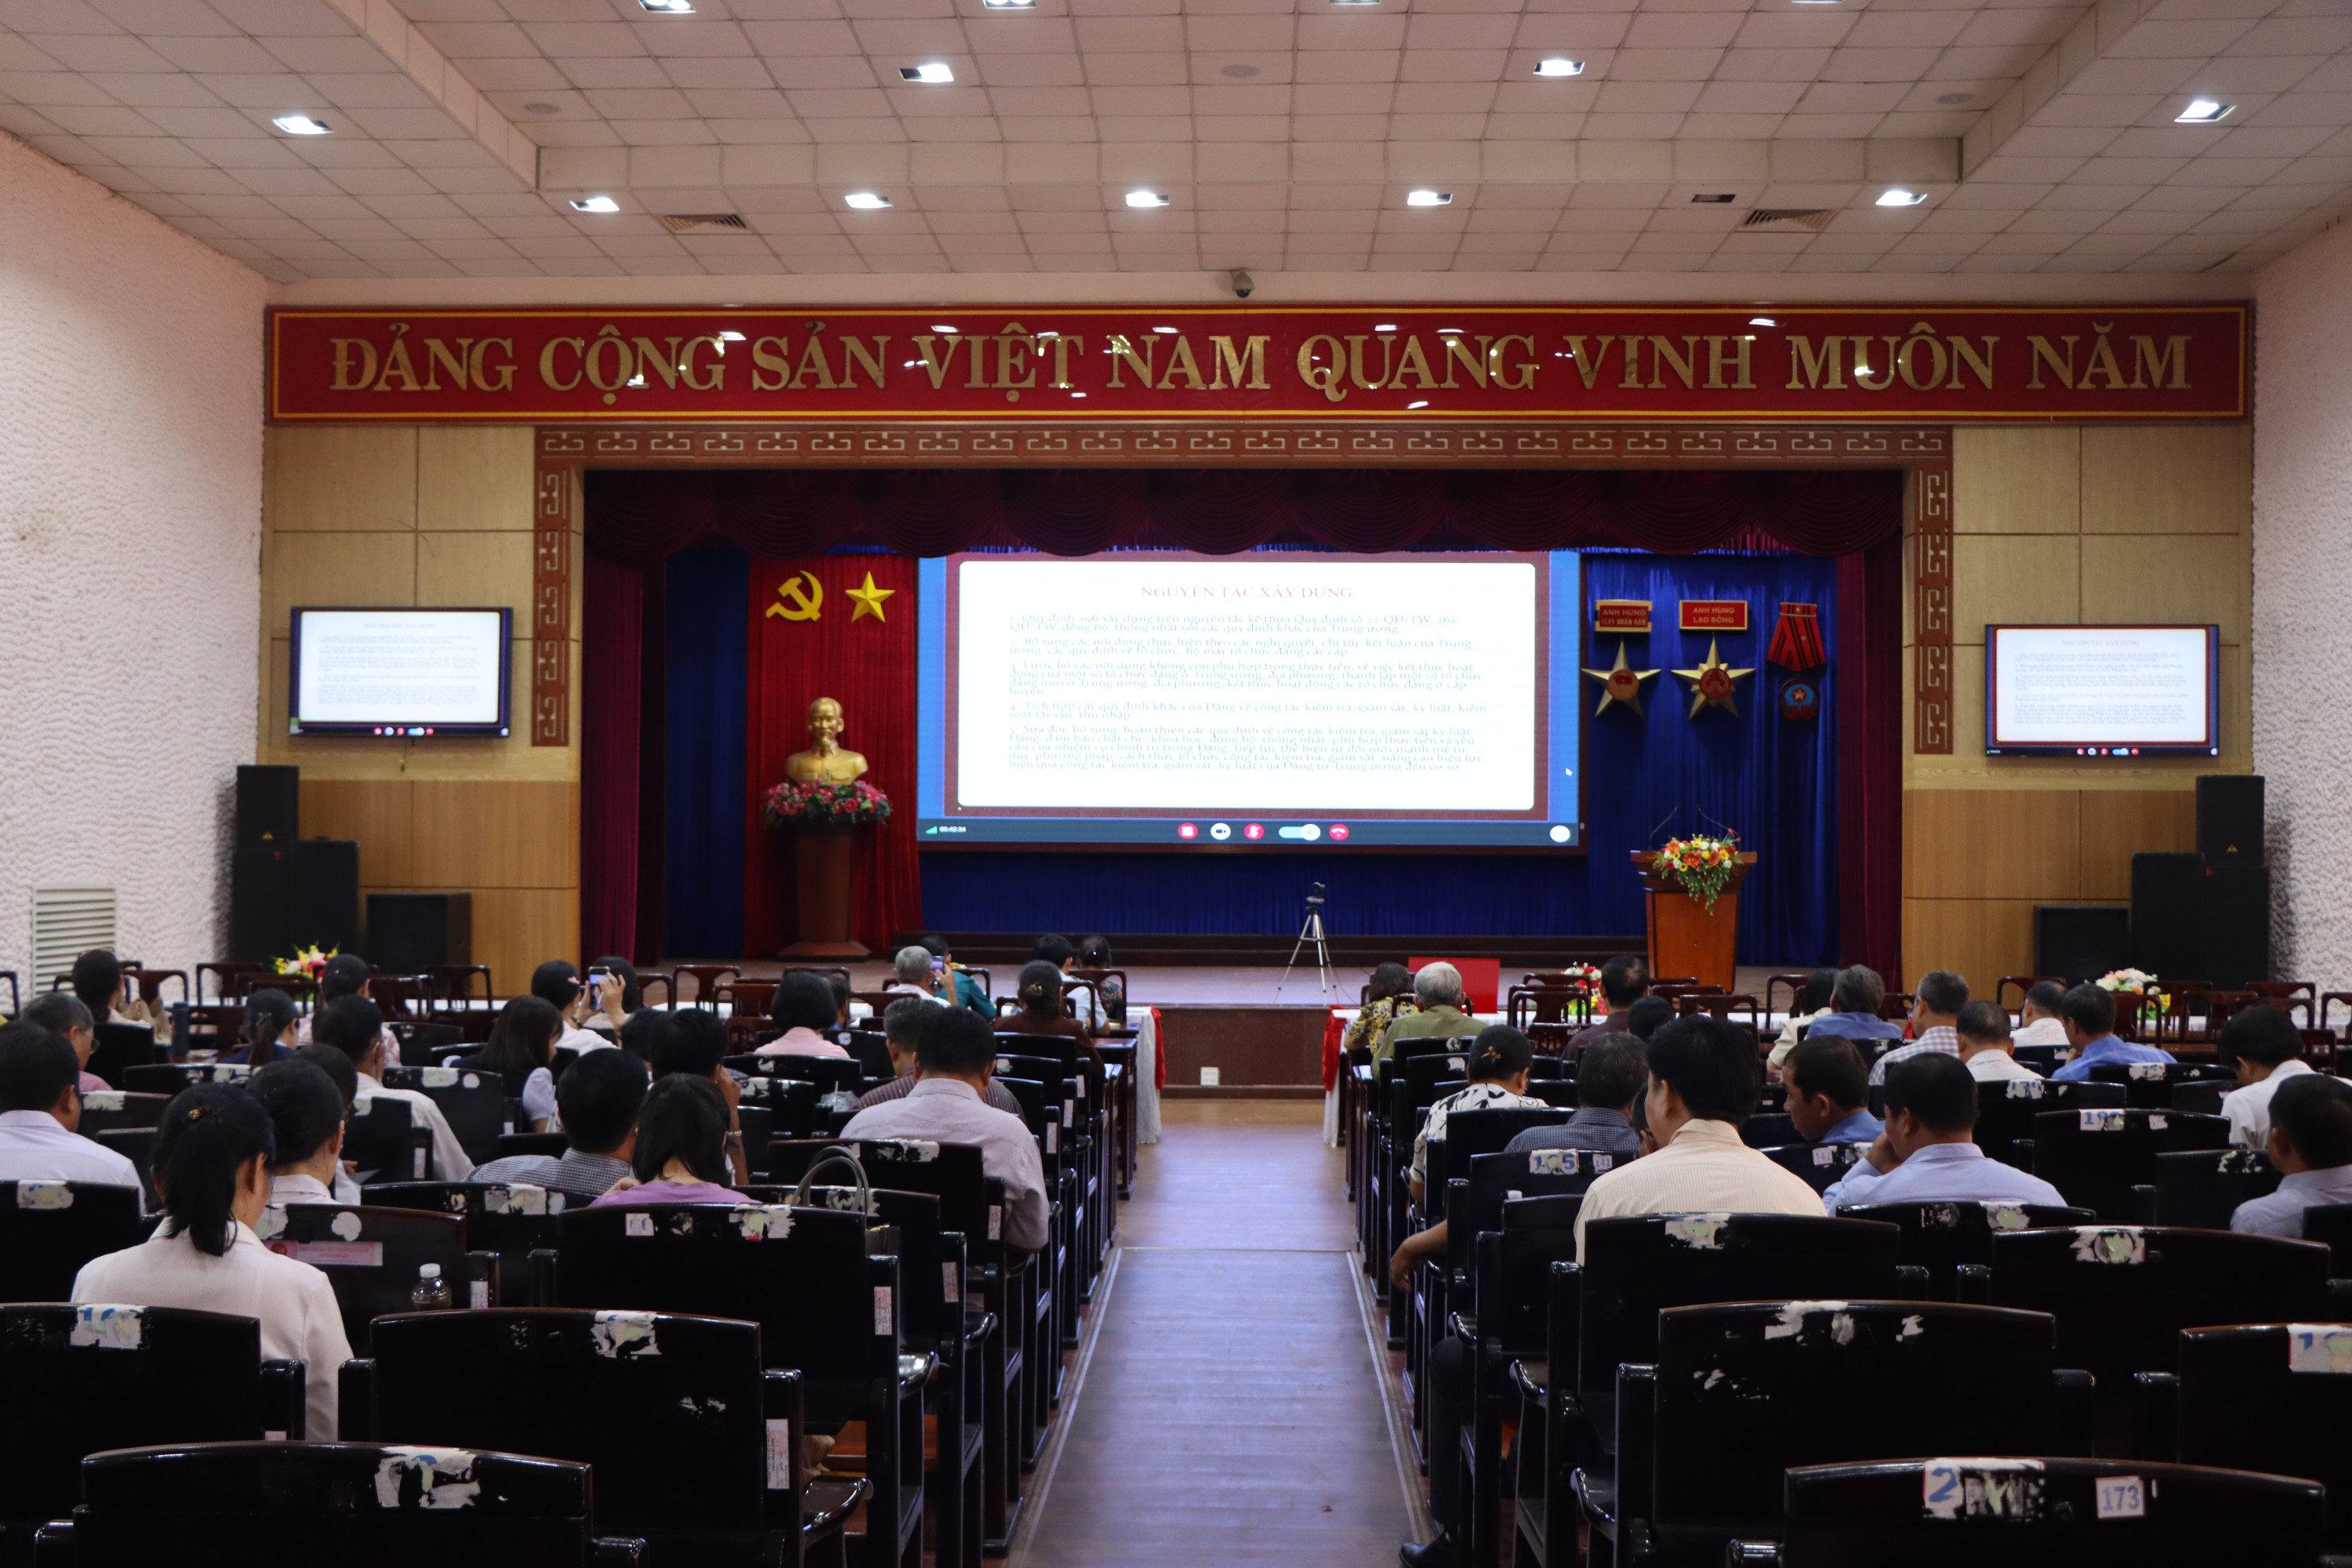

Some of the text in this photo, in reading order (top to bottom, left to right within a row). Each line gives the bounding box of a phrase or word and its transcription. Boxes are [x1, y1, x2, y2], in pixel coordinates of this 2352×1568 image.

[330, 321, 2192, 405] ĐẢNG CỘNG SẢN VIỆT NAM QUANG VINH MUÔN NĂM
[1141, 584, 1214, 597] NGUYÊN
[1259, 585, 1296, 597] XÂY
[1301, 586, 1352, 599] DỰNG
[1022, 612, 1045, 623] Quy
[1049, 613, 1074, 623] định
[1102, 613, 1118, 624] xây
[1123, 613, 1153, 624] dựng
[1156, 613, 1179, 622] trên
[1183, 613, 1224, 624] nguyên
[1228, 613, 1243, 622] tắc
[1248, 613, 1260, 622] kế
[1264, 614, 1290, 622] thừa
[1294, 614, 1317, 625] Quy
[1321, 614, 1347, 624] định
[1350, 614, 1362, 623] số
[1622, 608, 1646, 616] HÙNG
[1711, 615, 1734, 624] ĐỘNG
[1062, 621, 1090, 633] đồng
[1115, 622, 1148, 633] thống
[1152, 622, 1177, 631] nhất
[1181, 622, 1198, 631] với
[1202, 623, 1218, 631] các
[1247, 623, 1273, 633] định
[1277, 623, 1302, 631] khác
[1306, 623, 1326, 632] của
[1330, 623, 1363, 634] Trung
[1024, 635, 1038, 644] Bổ
[1042, 639, 1068, 647] sung
[1071, 636, 1088, 645] các
[1093, 637, 1111, 647] nội
[1114, 637, 1143, 648] dung
[1147, 637, 1172, 647] thực
[1177, 637, 1201, 647] hiện
[1205, 637, 1230, 646] theo
[1233, 637, 1250, 646] các
[1255, 637, 1280, 648] nghị
[1366, 637, 1382, 647] kết
[1386, 638, 1411, 648] luận
[1414, 638, 1434, 647] của
[1438, 638, 1471, 649] Trung
[1047, 645, 1063, 654] các
[1068, 648, 1087, 656] quy
[1091, 645, 1117, 656] định
[1121, 645, 1133, 654] về
[1136, 645, 1147, 654] tổ
[1186, 646, 1200, 656] bộ
[1203, 646, 1225, 657] máy
[1230, 645, 1241, 654] tổ
[1244, 646, 1271, 655] chức
[1275, 646, 1303, 657] đảng
[1306, 646, 1323, 655] các
[1024, 660, 1053, 671] Lược
[1057, 660, 1071, 669] bỏ
[1074, 660, 1091, 669] các
[1095, 660, 1113, 671] nội
[1117, 660, 1145, 671] dung
[1149, 660, 1185, 672] không
[1188, 661, 1208, 669] còn
[1212, 661, 1234, 672] phù
[1238, 661, 1261, 672] hợp
[1264, 661, 1295, 672] trong
[1298, 661, 1324, 672] thực
[1357, 661, 1369, 670] về
[1373, 661, 1393, 672] việc
[1398, 661, 1414, 670] kết
[1418, 662, 1443, 671] thúc
[1448, 662, 1472, 672] hoạt
[1024, 700, 1048, 709] Tích
[1053, 701, 1075, 712] hợp
[1078, 701, 1094, 710] các
[1099, 704, 1118, 712] quy
[1123, 701, 1149, 712] định
[1153, 701, 1178, 710] khác
[1182, 701, 1201, 710] của
[1206, 701, 1235, 713] Đảng
[1239, 701, 1250, 711] về
[1254, 702, 1281, 713] công
[1285, 702, 1300, 711] tác
[1305, 701, 1333, 711] kiểm
[1359, 702, 1386, 714] giám
[1458, 702, 1486, 712] kiểm
[1009, 759, 1033, 770] hiệu
[1036, 759, 1057, 770] quả
[1060, 759, 1087, 771] công
[1091, 759, 1106, 768] tác
[1111, 759, 1139, 768] kiểm
[1164, 760, 1192, 771] giám
[1235, 760, 1256, 771] luật
[1260, 760, 1279, 769] của
[1283, 760, 1313, 772] Đảng
[1316, 760, 1329, 769] từ
[1334, 761, 1367, 772] Trung
[1370, 764, 1401, 772] ương
[1405, 760, 1426, 770] đến
[1534, 1154, 1575, 1171] 15
[1596, 1158, 1610, 1167] 141
[2102, 1485, 2140, 1511] 173
